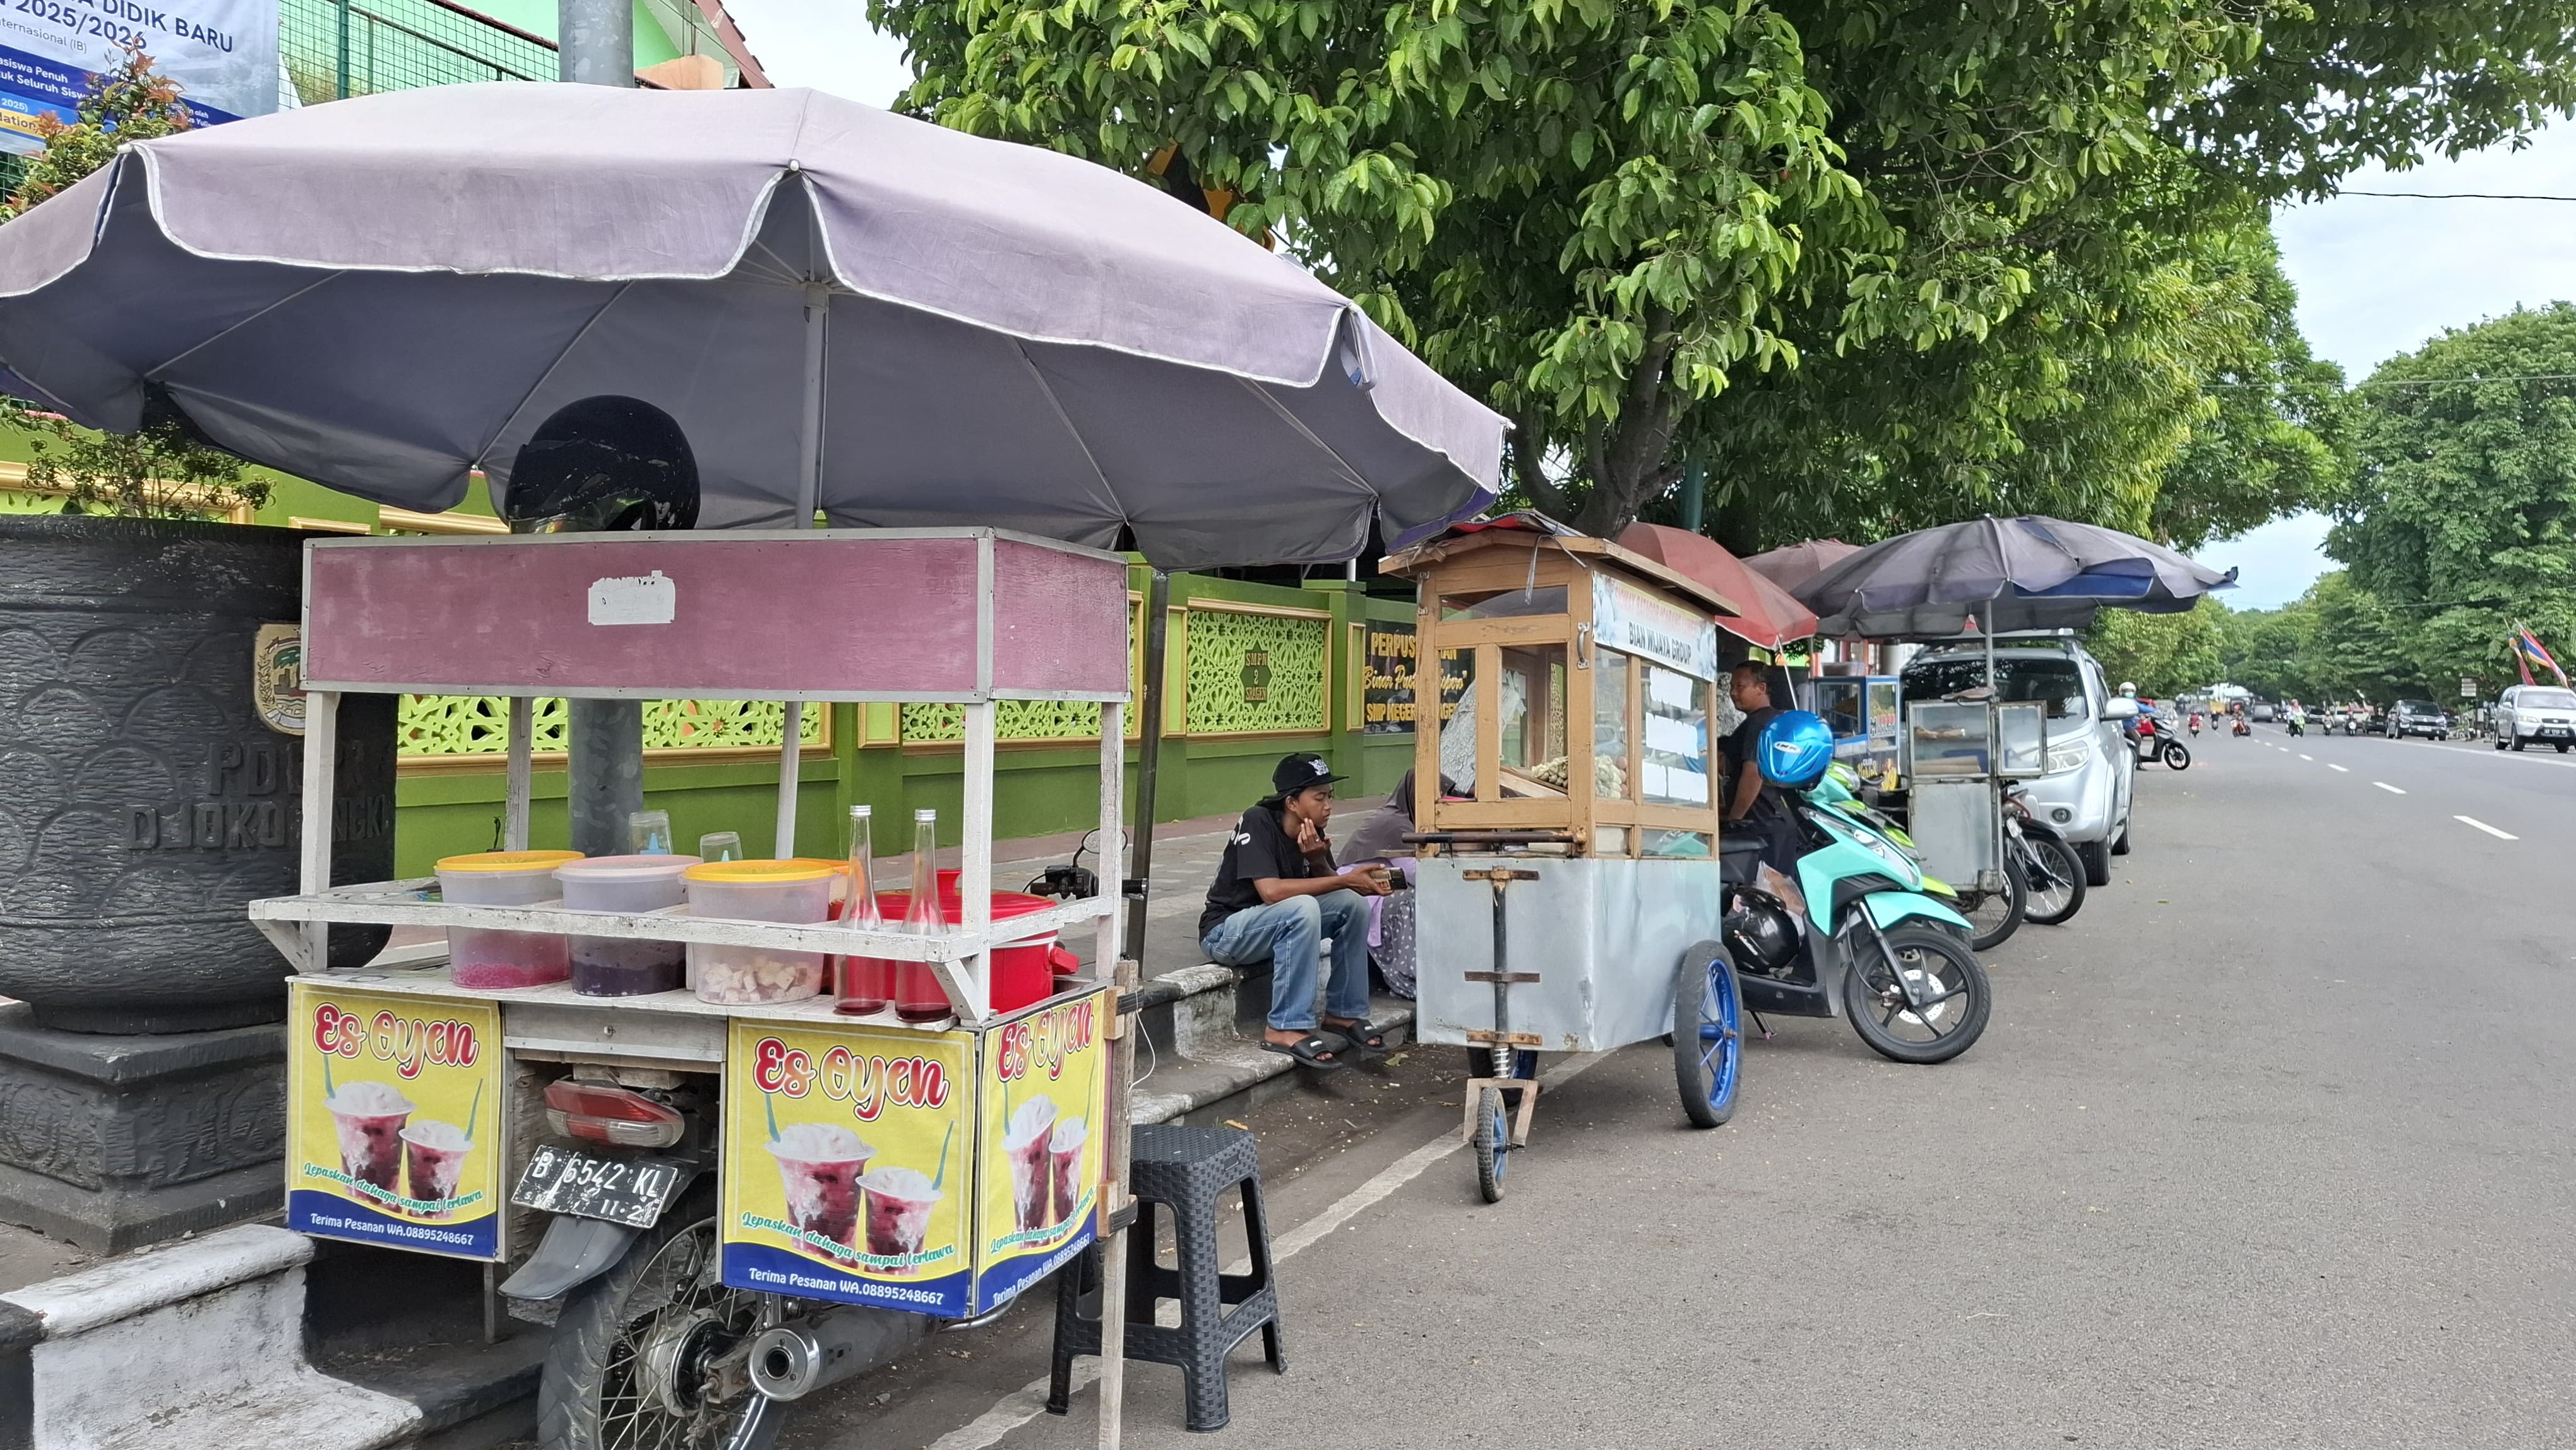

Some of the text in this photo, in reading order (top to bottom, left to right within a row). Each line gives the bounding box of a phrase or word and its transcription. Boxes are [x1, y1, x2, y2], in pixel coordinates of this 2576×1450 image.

[103, 0, 232, 52] DIDIK BARU
[17, 75, 59, 94] Seluruh
[35, 66, 68, 83] Penuh
[1246, 652, 1267, 667] SMPN
[1629, 621, 1691, 664] BIAN WIJAYA GROUP
[1253, 669, 1259, 685] 2
[1366, 703, 1386, 721] SMP
[313, 1003, 479, 1079] Es Oyen
[996, 998, 1094, 1082] Es Oyen
[753, 1037, 950, 1122] Es Oyen
[304, 1162, 483, 1214] Lepaskan dahaga sampai tertawa
[532, 1151, 661, 1197] B 6542 KL
[311, 1213, 474, 1246] Terima Pesanan WA.08895248667
[741, 1211, 955, 1268] Lepaskan dahaga sampai tertawa
[749, 1267, 943, 1305] Terima Pesanan WA.08895248667
